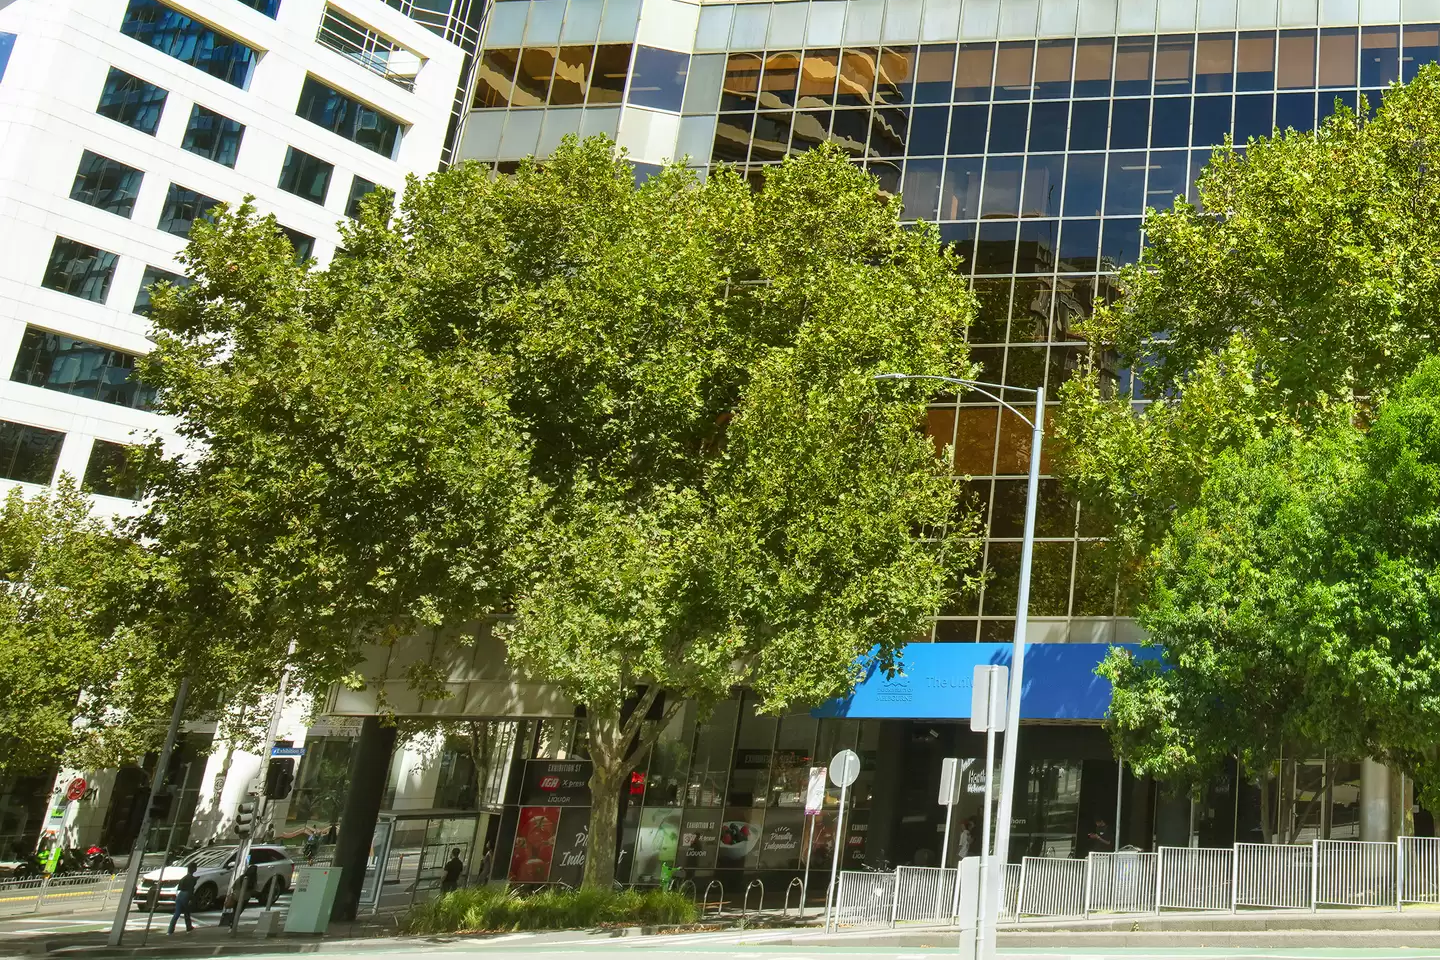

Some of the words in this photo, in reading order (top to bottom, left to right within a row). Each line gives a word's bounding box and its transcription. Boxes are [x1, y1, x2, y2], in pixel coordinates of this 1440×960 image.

[541, 777, 560, 788] IGA
[849, 836, 863, 844] IGA
[763, 841, 798, 851] Independent
